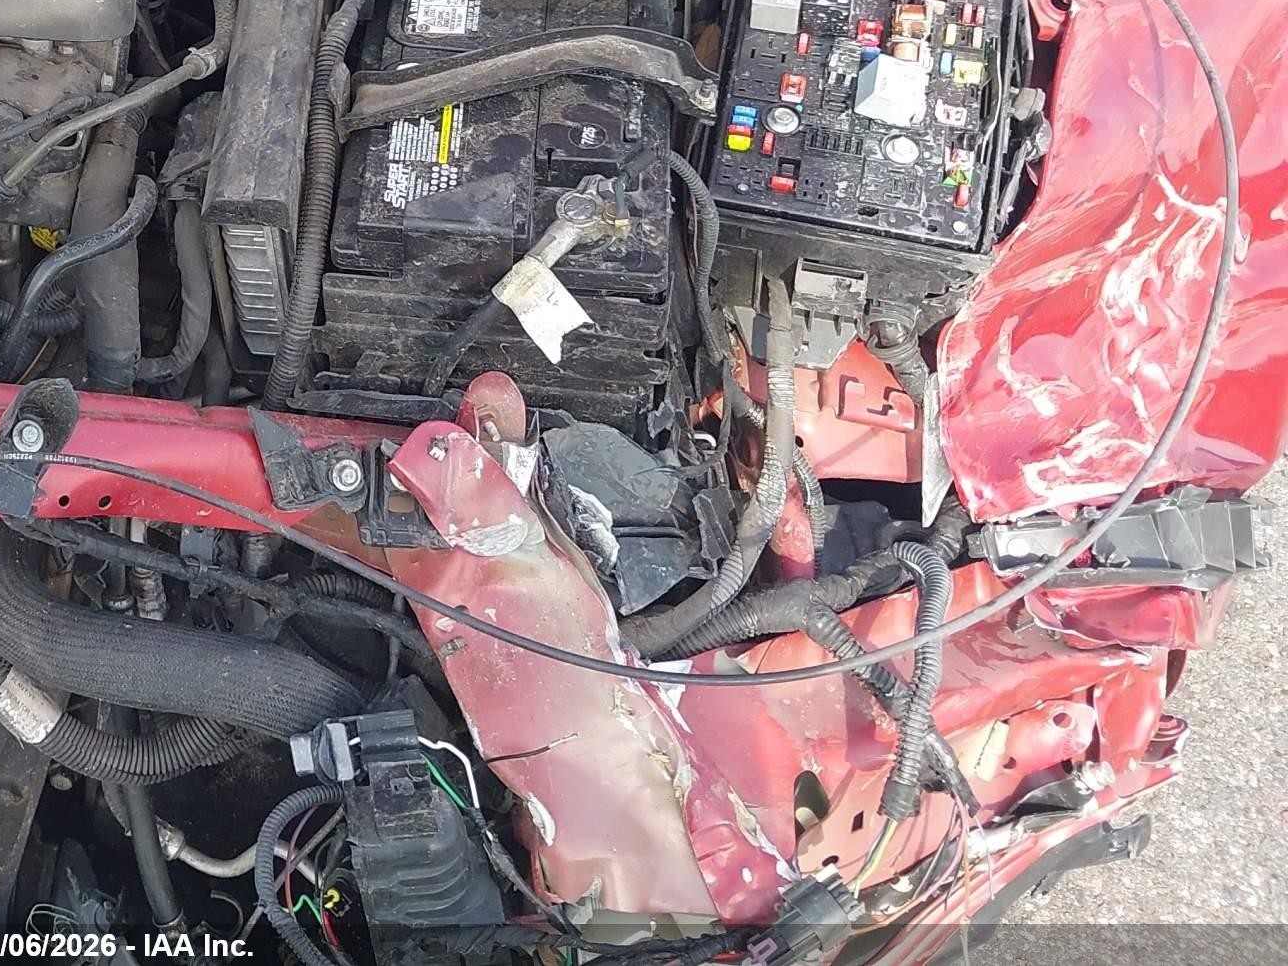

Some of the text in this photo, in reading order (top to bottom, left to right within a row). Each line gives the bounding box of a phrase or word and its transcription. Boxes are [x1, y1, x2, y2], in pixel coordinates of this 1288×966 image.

[581, 125, 596, 147] 7/25
[383, 162, 399, 203] SUPER
[393, 161, 410, 209] START
